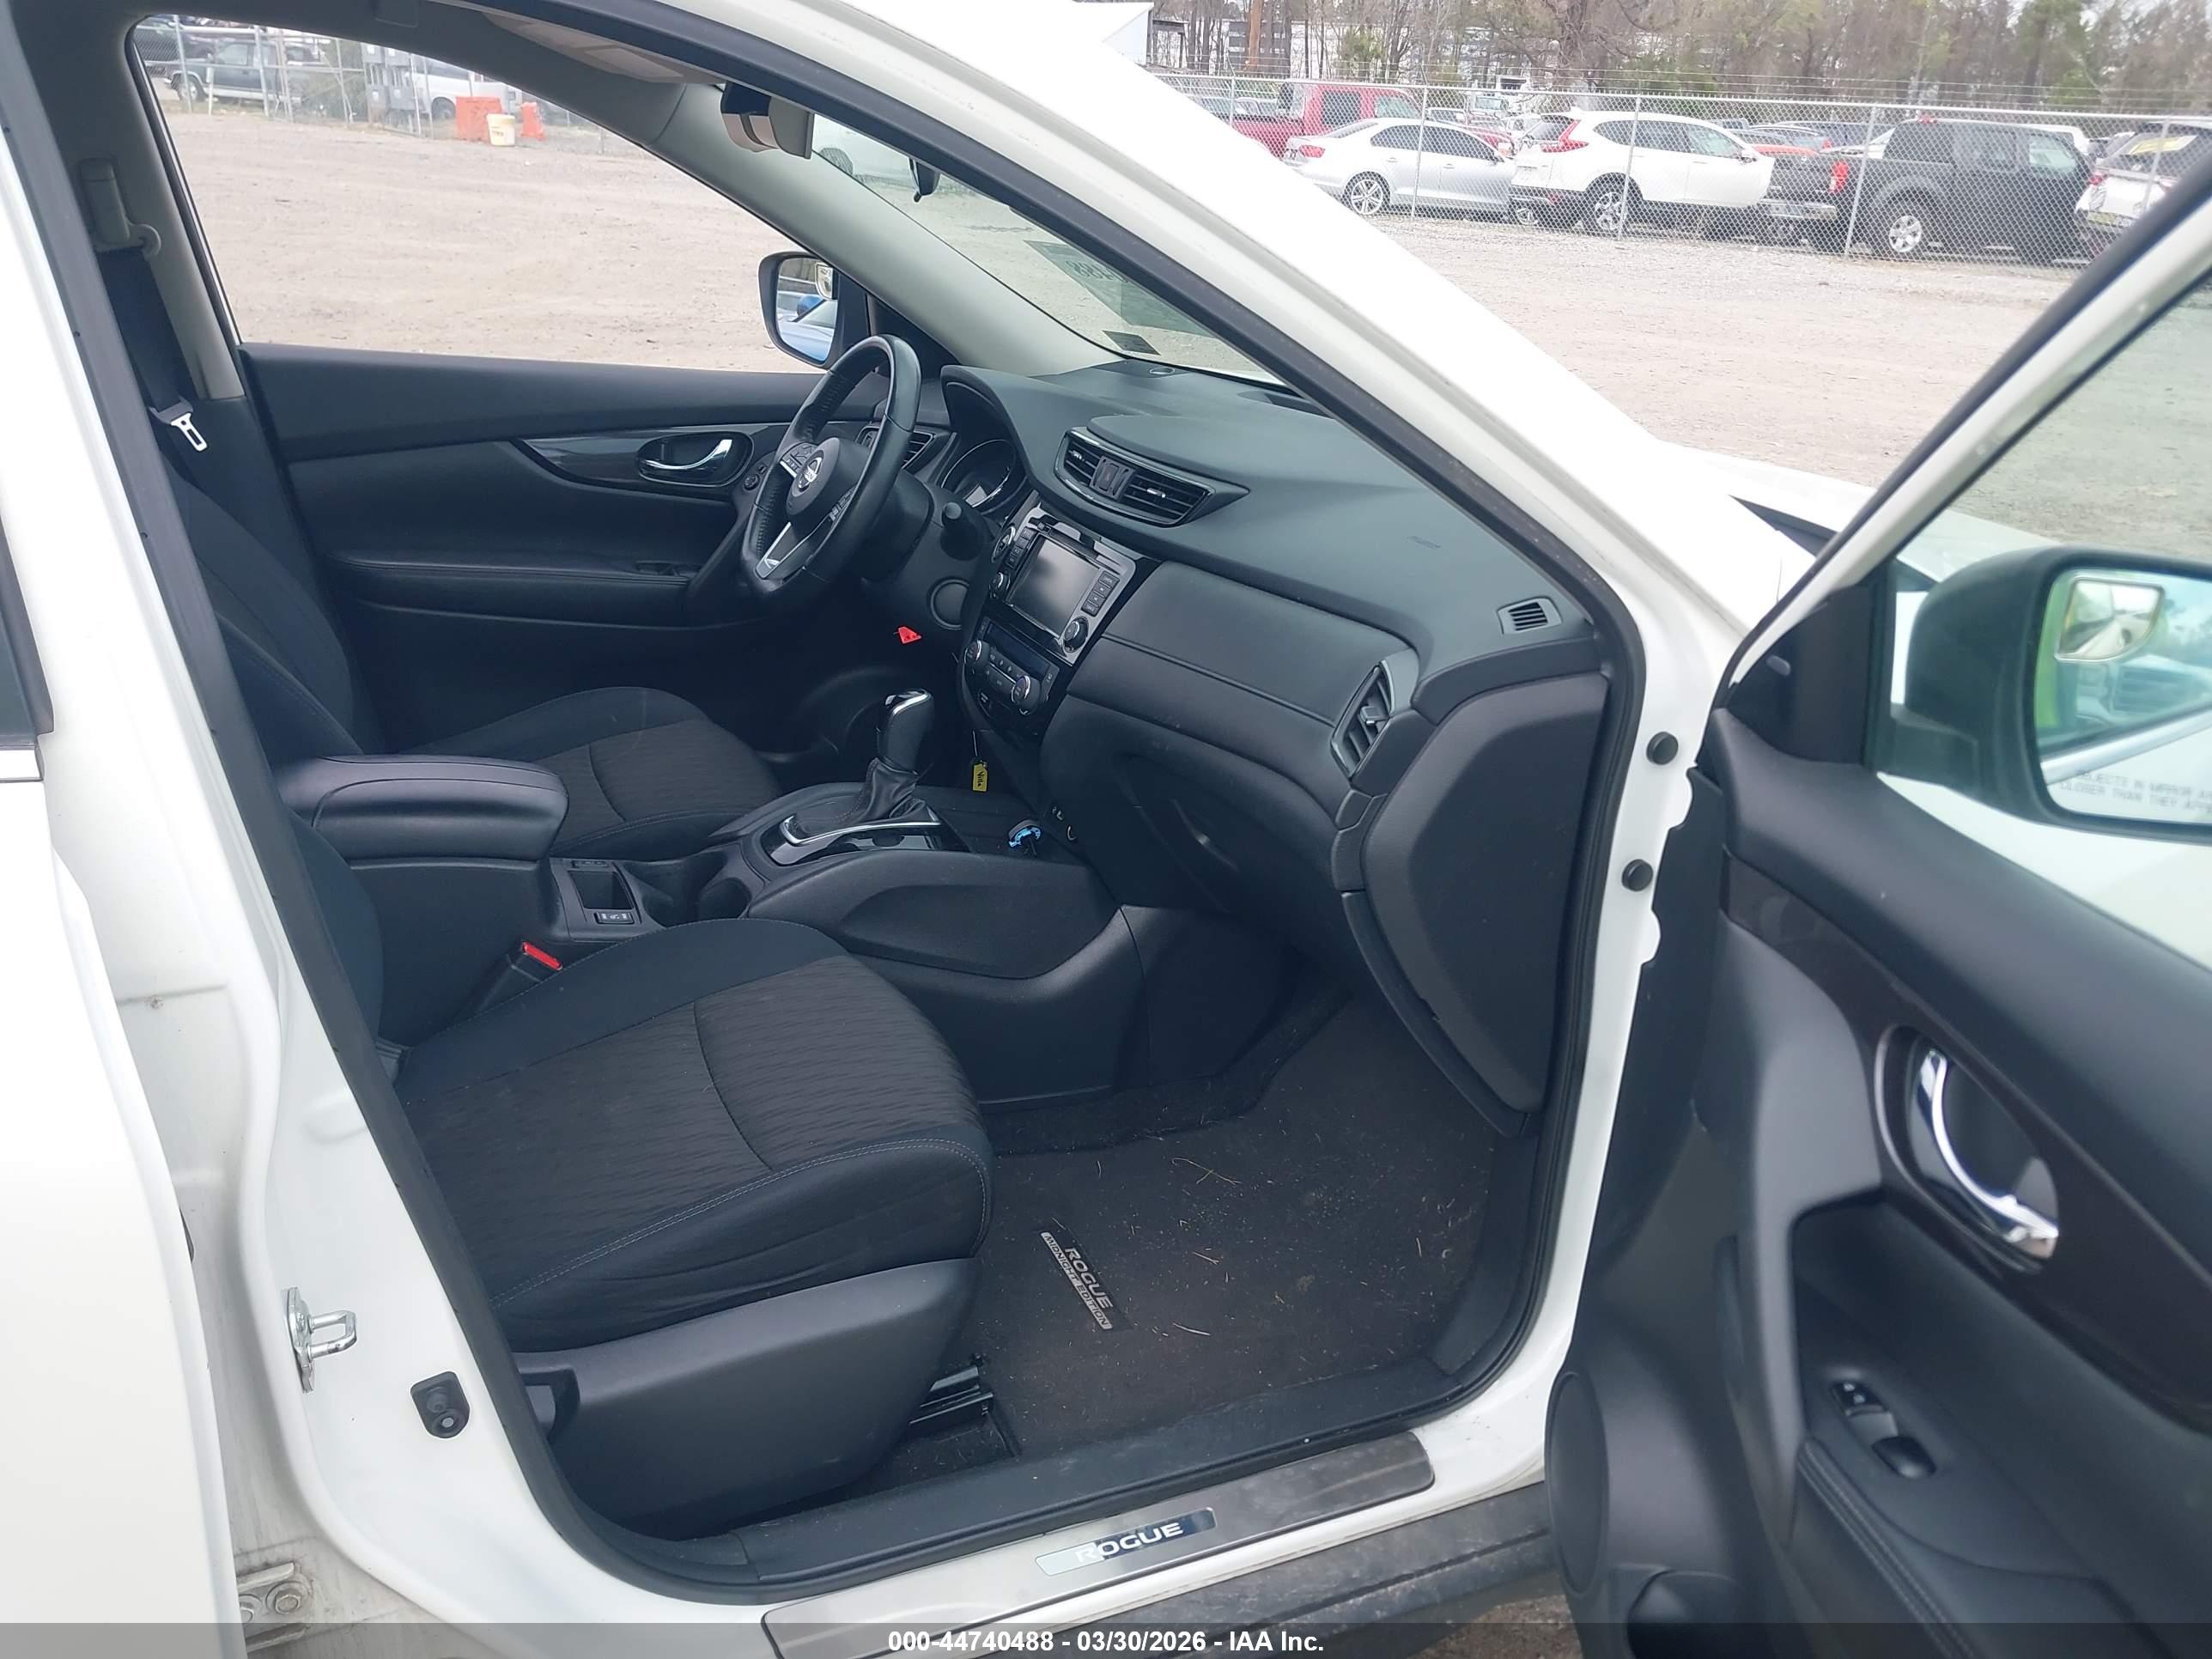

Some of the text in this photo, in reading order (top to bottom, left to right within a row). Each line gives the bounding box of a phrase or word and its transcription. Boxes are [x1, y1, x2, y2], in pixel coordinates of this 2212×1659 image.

[1044, 1236, 1109, 1326] MIDNIGHT EDITION
[1064, 1247, 1114, 1310] ROGUE
[1075, 1522, 1184, 1563] ROGUE
